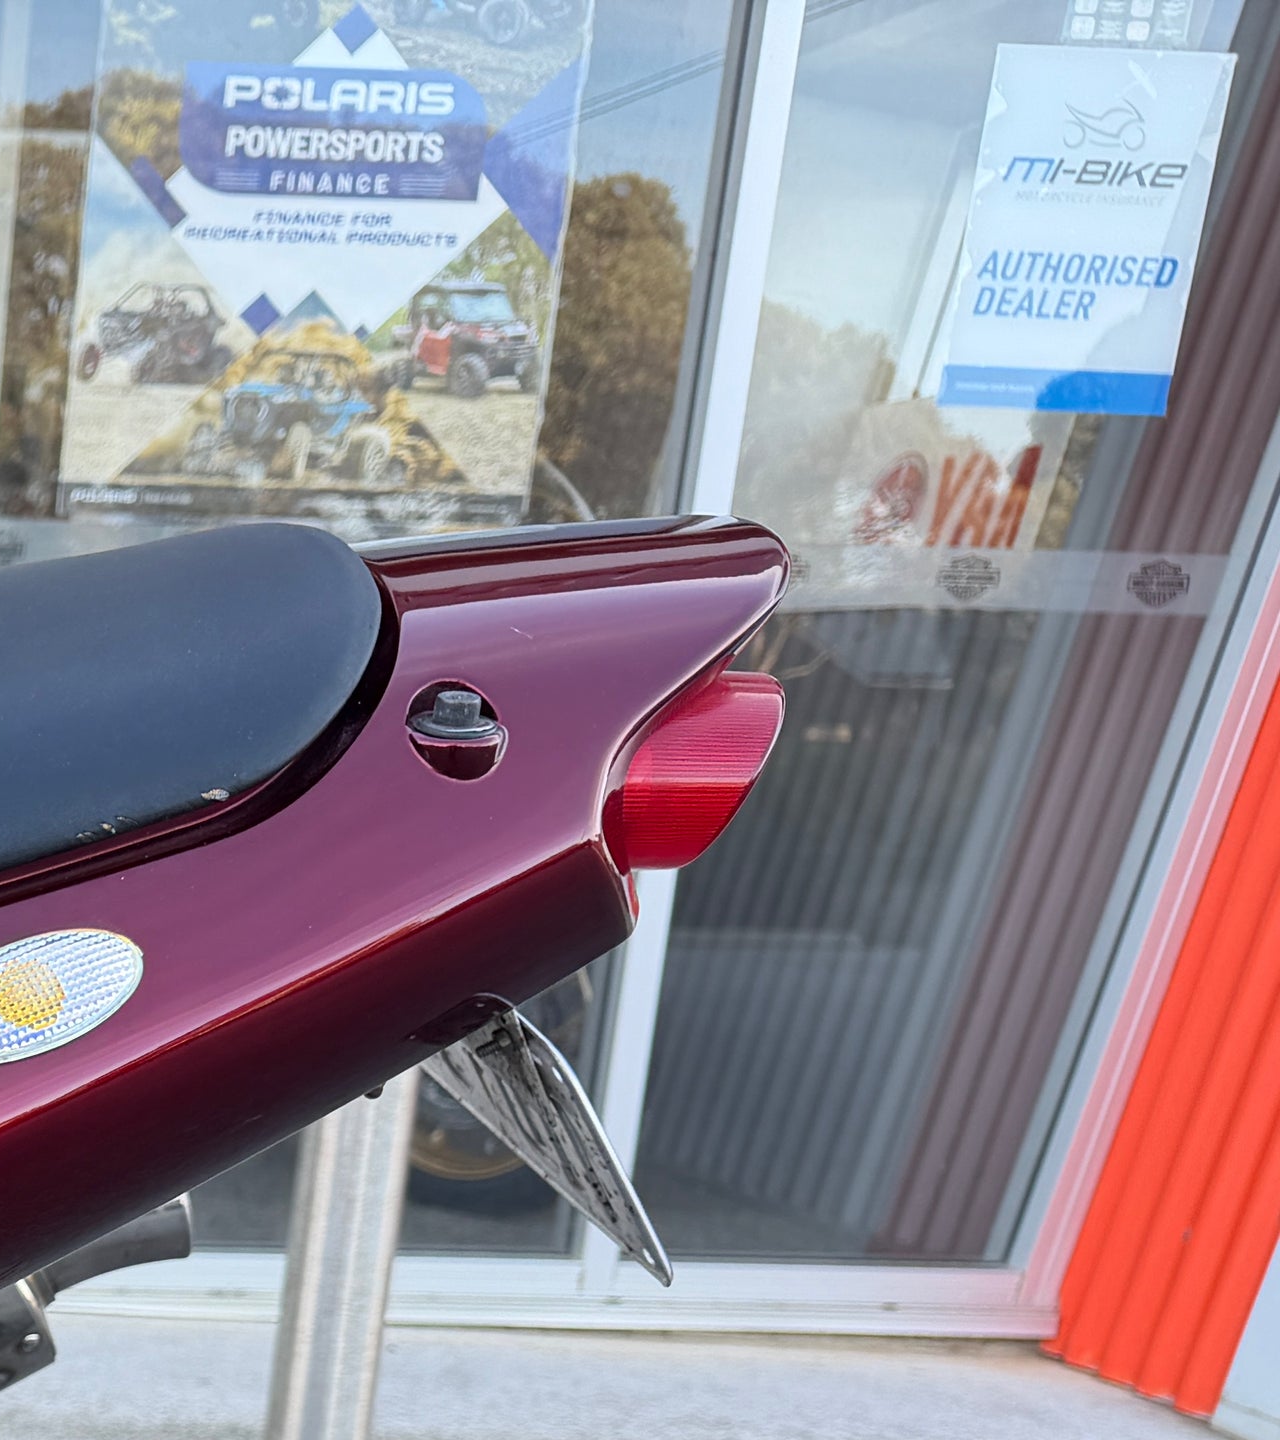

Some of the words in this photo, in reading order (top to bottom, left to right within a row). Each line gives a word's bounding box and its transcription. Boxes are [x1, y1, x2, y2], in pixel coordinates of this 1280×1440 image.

[223, 75, 455, 115] POLARIS
[225, 125, 445, 163] POWERSPORTS
[269, 170, 390, 195] FINANCE
[253, 209, 345, 226] FINANCE
[350, 211, 392, 227] FOR
[184, 227, 339, 245] RECREATIONAL
[345, 231, 458, 248] PRODUCTS
[977, 250, 1179, 289] AUTHORISED
[973, 286, 1096, 321] DEALER
